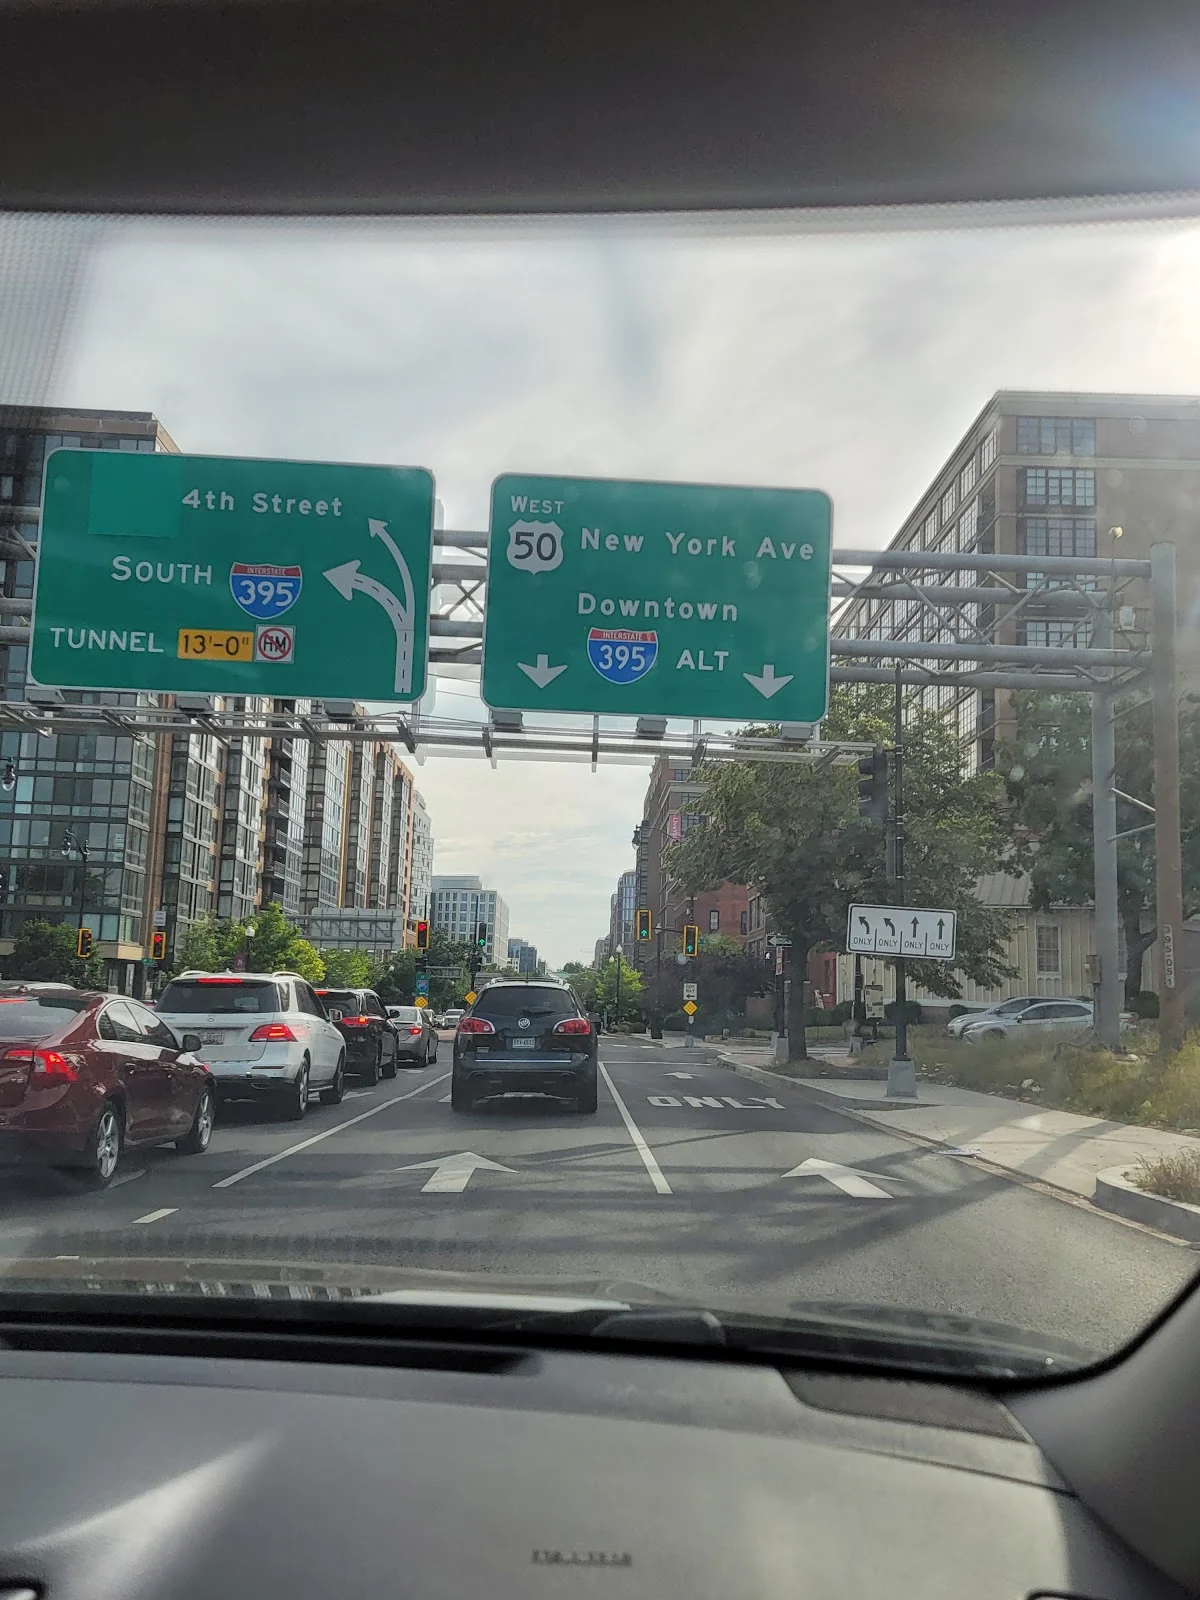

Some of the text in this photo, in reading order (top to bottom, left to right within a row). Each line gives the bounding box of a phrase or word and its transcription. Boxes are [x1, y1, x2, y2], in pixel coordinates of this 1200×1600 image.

[181, 488, 344, 517] 4th Street
[510, 495, 565, 515] WEST
[513, 531, 557, 562] 50
[581, 528, 814, 561] New York Ave
[111, 555, 212, 585] SOUTH
[246, 566, 287, 577] INTERSTATE
[237, 580, 294, 608] 395
[577, 592, 739, 622] Downtown
[50, 627, 164, 653] TUNNEL
[602, 631, 643, 641] INTERSTATE
[598, 644, 647, 672] 395
[676, 649, 730, 672] ALT
[853, 936, 873, 946] ONLY
[878, 938, 898, 947] ONLY
[904, 940, 924, 950] ONLY
[929, 942, 950, 952] ONLY
[646, 1096, 786, 1109] ONLY
